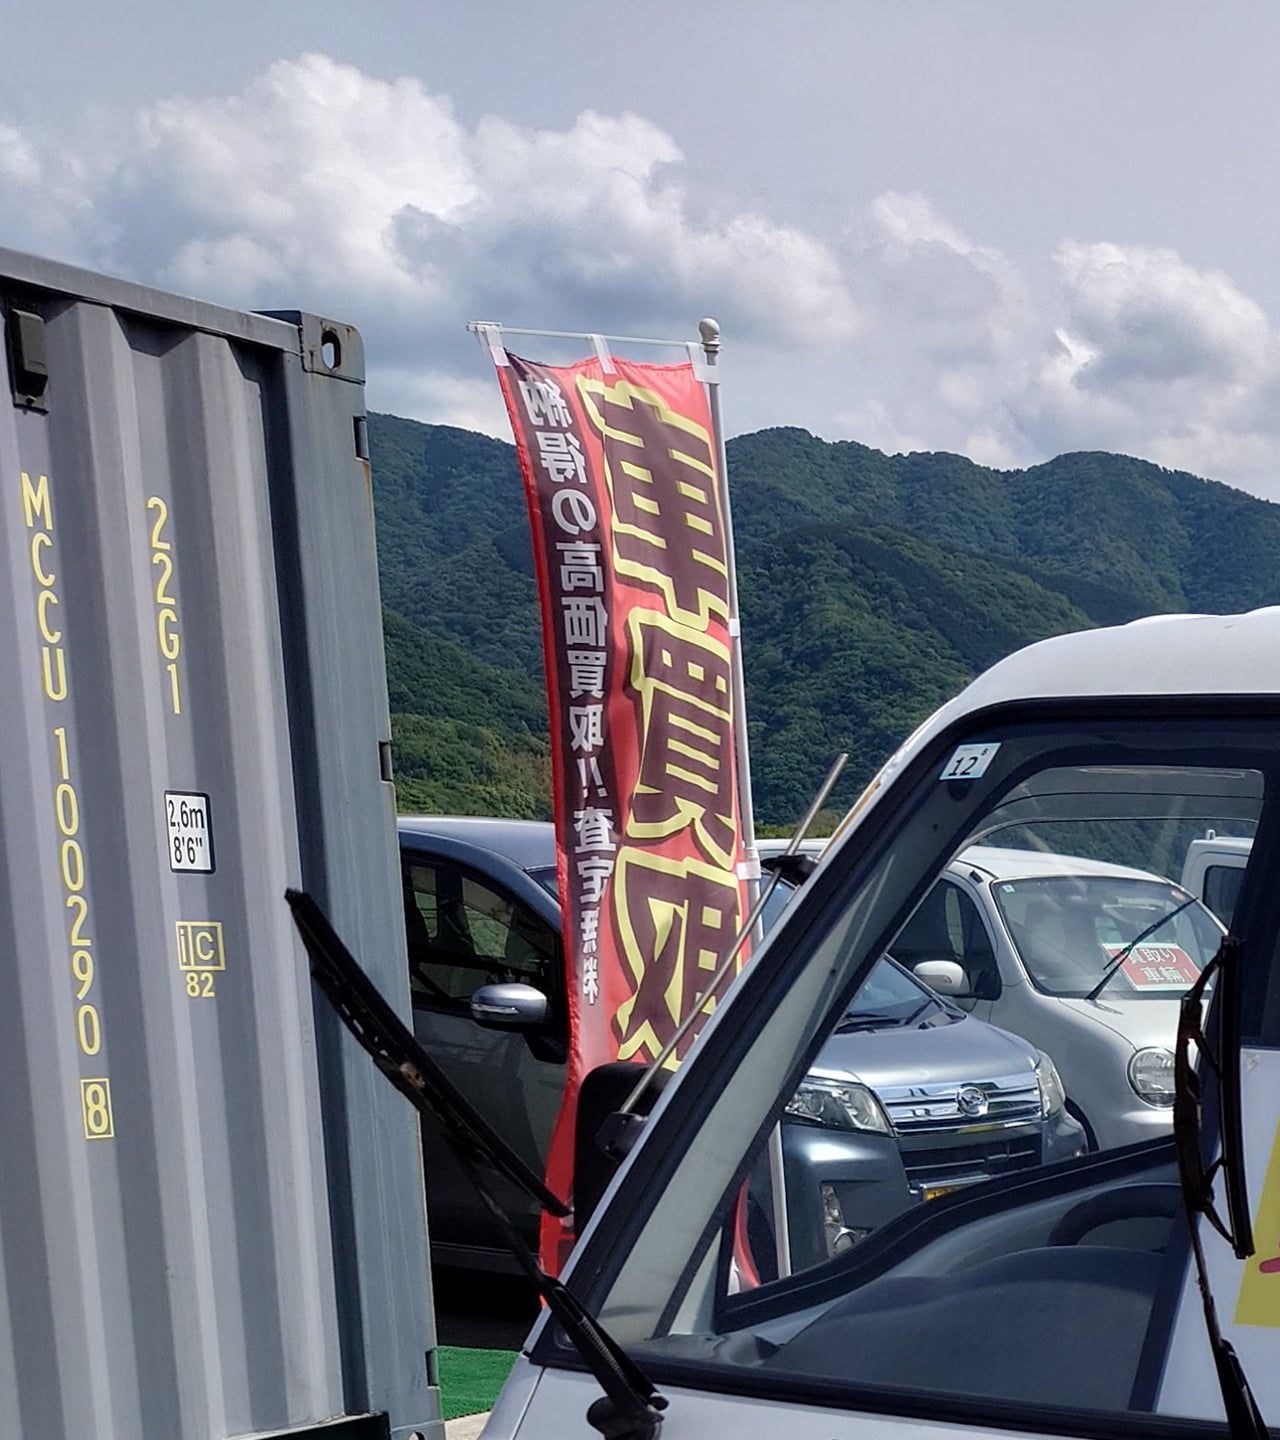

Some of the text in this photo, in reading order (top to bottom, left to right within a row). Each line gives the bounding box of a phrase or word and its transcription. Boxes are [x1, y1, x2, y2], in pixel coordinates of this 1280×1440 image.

[147, 496, 180, 714] 22G1
[948, 756, 978, 776] 12
[21, 472, 108, 1133] MCCU 100290 8
[168, 800, 205, 832] 2,6m
[186, 972, 215, 998] 82
